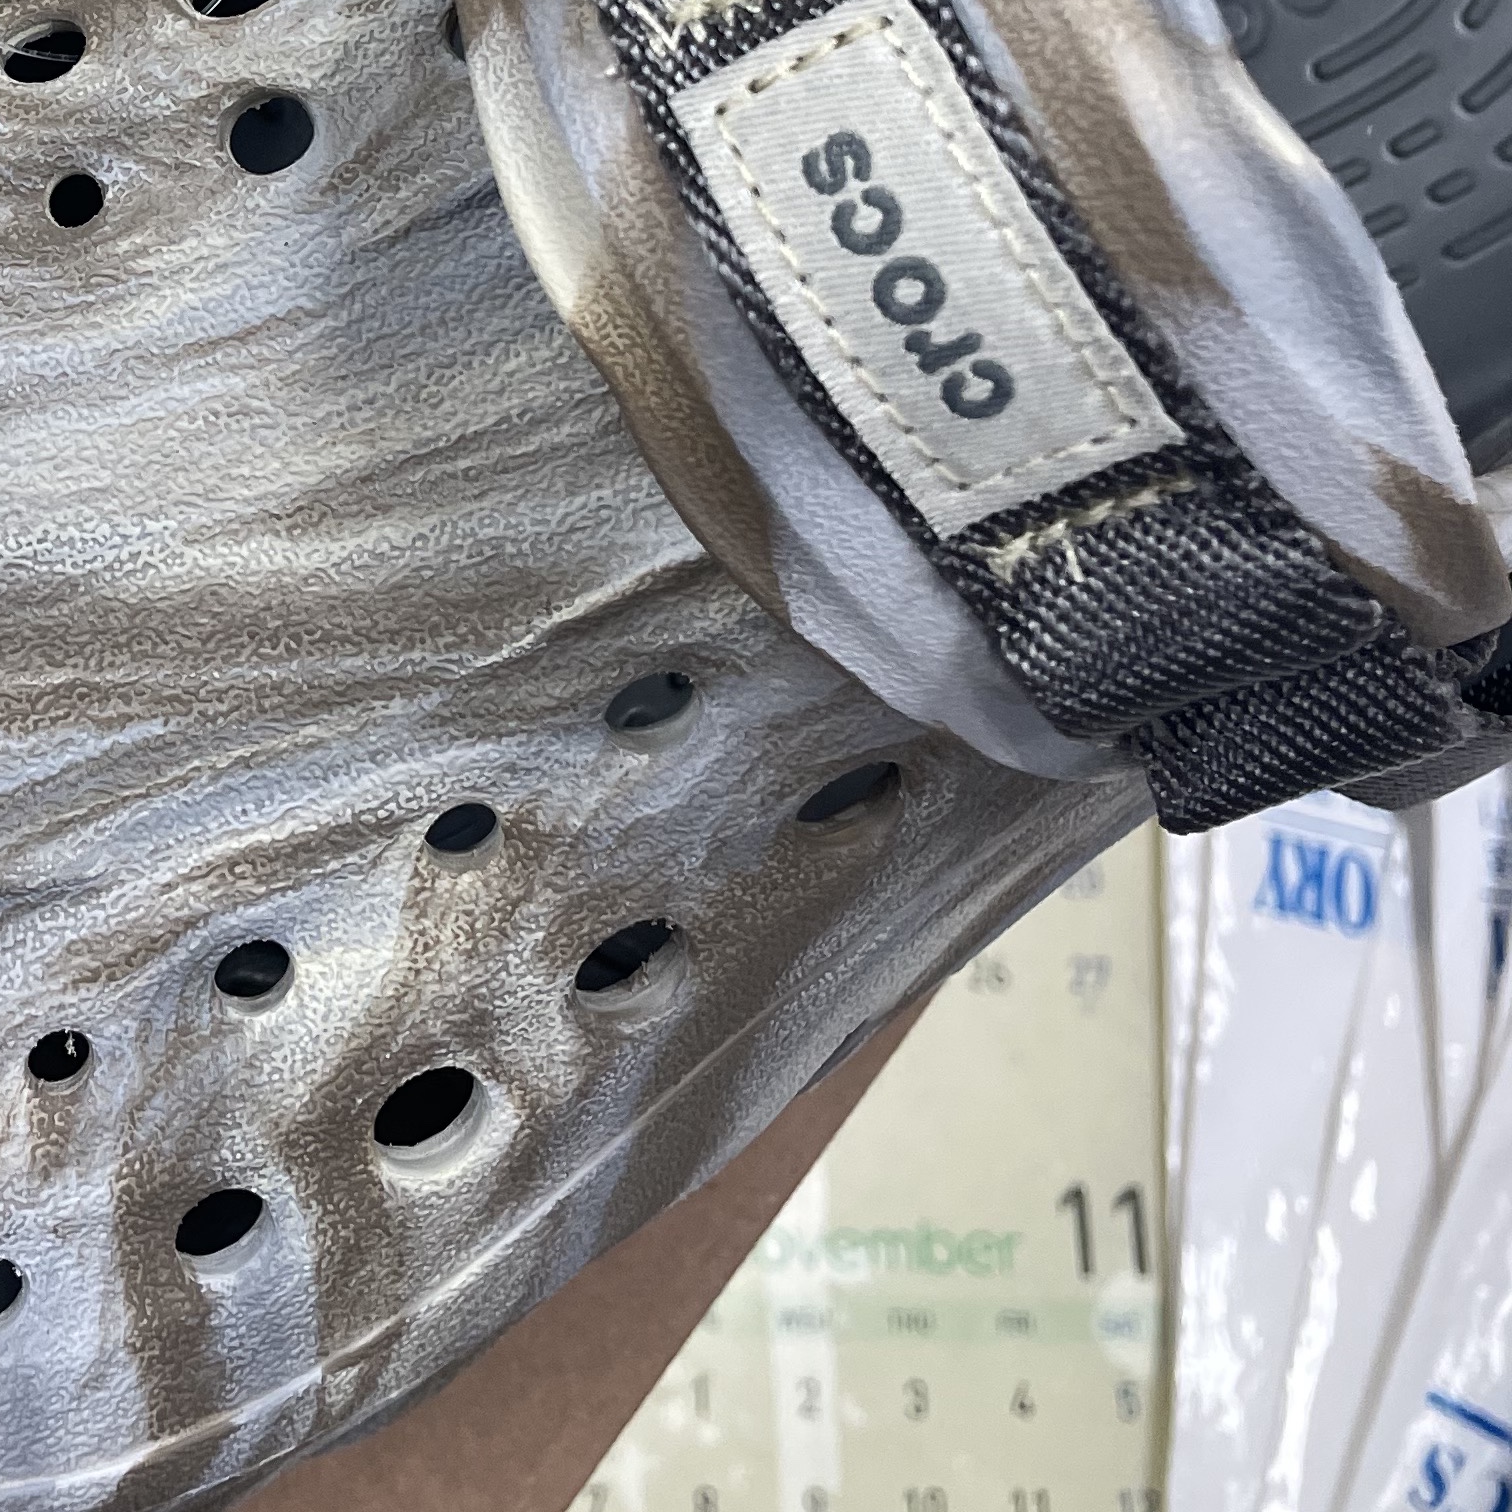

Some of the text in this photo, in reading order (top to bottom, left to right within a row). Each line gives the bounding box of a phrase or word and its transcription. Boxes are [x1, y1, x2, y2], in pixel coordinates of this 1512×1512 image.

[796, 128, 1016, 422] crocs
[1054, 1179, 1152, 1281] 11
[795, 1376, 823, 1422] 2
[902, 1377, 930, 1422] 3
